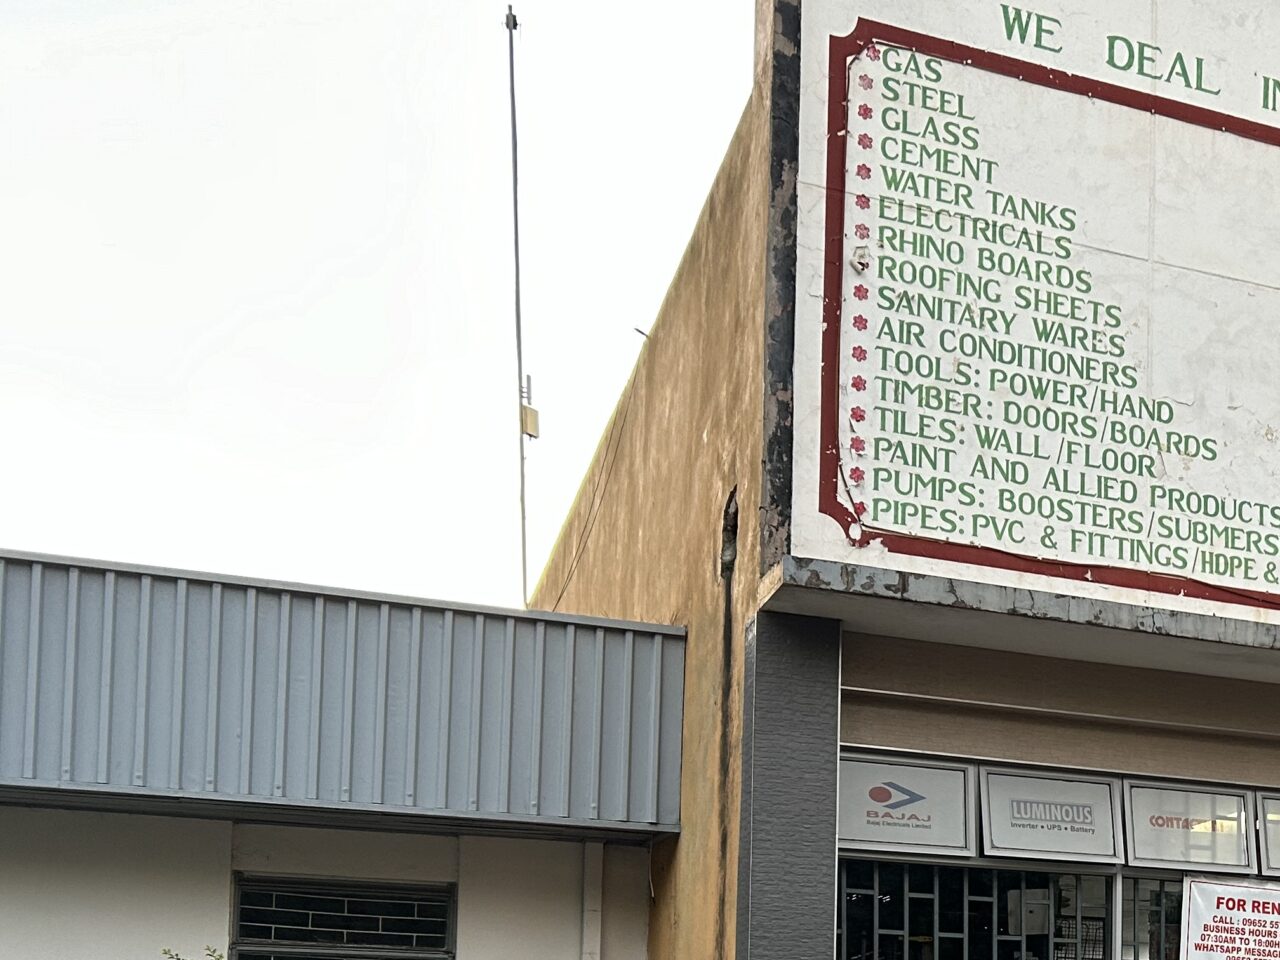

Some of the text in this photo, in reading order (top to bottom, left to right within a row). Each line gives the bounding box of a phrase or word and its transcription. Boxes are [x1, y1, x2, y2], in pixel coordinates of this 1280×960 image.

[882, 48, 942, 83] GAS
[1000, 5, 1062, 53] WE
[1105, 35, 1221, 96] DEAL
[881, 77, 975, 120] STEEL
[880, 107, 980, 150] GLASS
[880, 136, 999, 184] CEMENT
[879, 165, 1076, 231] WATER TANKS
[878, 195, 1072, 260] ELECTRICALS
[877, 225, 1092, 293] RHINO BOARDS
[877, 255, 1121, 328] ROOFING SHEETS
[876, 285, 1126, 358] SANITARY WARES
[876, 316, 1138, 389] AIR CONDITIONERS
[874, 346, 1175, 425] TOOLS: POWER/HAND
[873, 406, 966, 446] TILES:
[874, 376, 1218, 461] TIMBER: DOORS/BOARDS
[872, 466, 985, 508] PUMPS:
[873, 437, 958, 473] PAINT
[970, 454, 1029, 485] AND
[1042, 466, 1138, 504] ALLIED
[871, 497, 965, 534] PIPES:
[972, 514, 1026, 544] PVC
[1040, 525, 1058, 550] &
[1263, 562, 1280, 585] &
[866, 810, 931, 822] BAJAJ
[1010, 822, 1096, 835] Inverter UPS Battery
[1011, 800, 1093, 824] LUMINOUS
[1212, 915, 1235, 926] CALL
[1242, 917, 1268, 929] 09652
[1215, 896, 1247, 912] FOR
[1194, 942, 1242, 955] WHATSAPP
[1200, 933, 1237, 945] 07:30AM
[1239, 937, 1250, 946] TO
[1203, 924, 1246, 936] BUSINESS
[1248, 928, 1278, 939] HOURS
